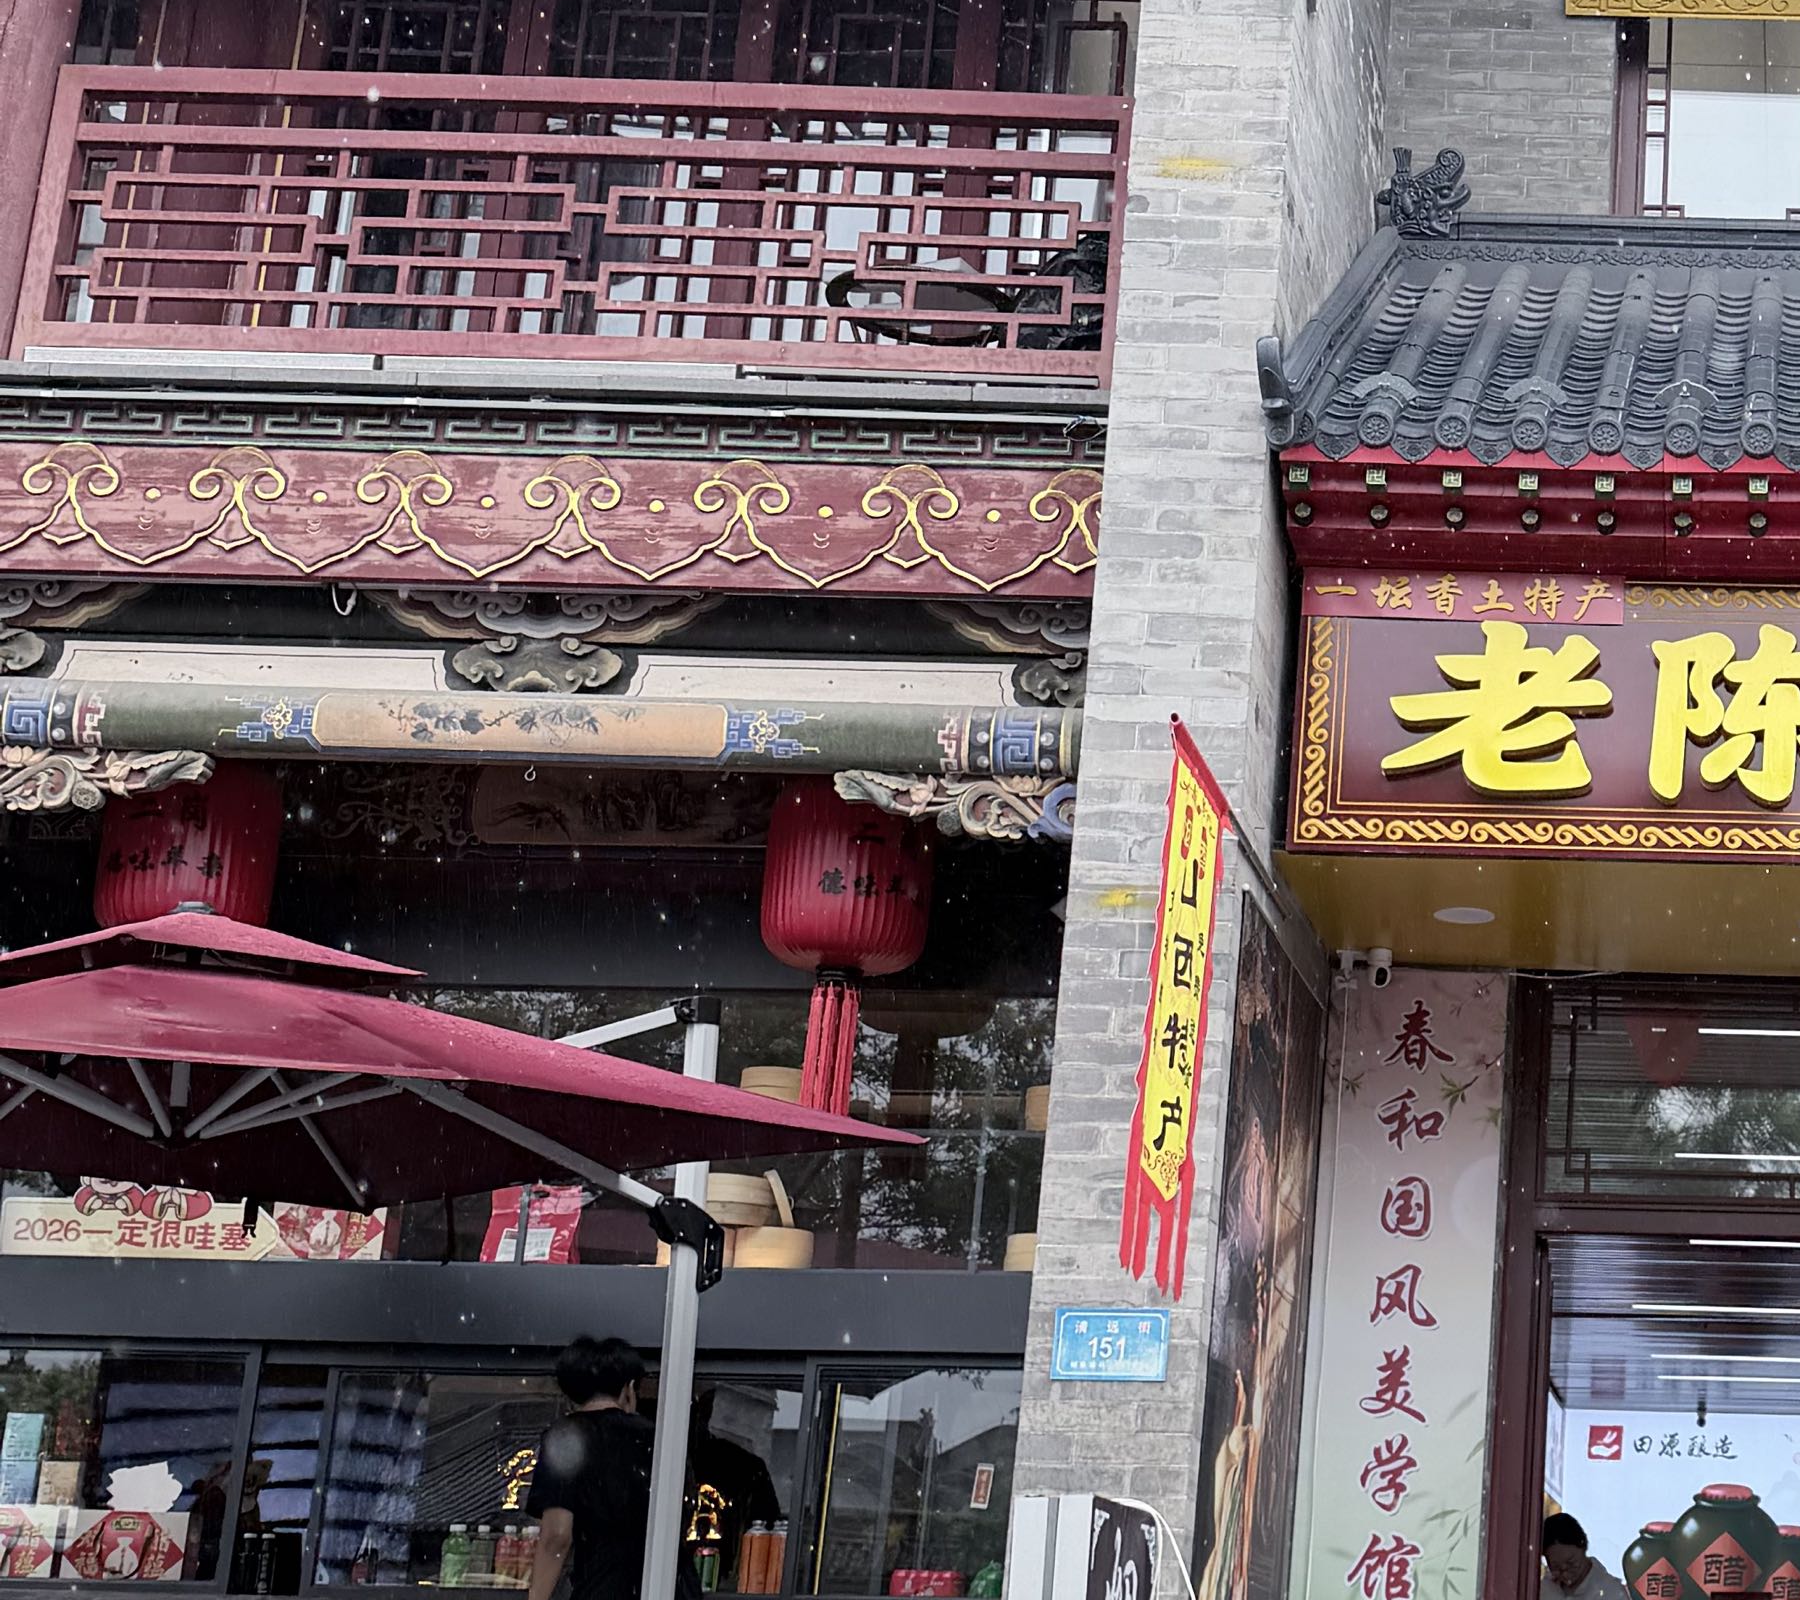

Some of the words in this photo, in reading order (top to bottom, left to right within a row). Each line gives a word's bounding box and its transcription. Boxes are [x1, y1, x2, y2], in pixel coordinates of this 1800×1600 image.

[1313, 572, 1615, 622] 一坛香土特产
[13, 1217, 254, 1252] 2026一定很哇塞
[1087, 1336, 1127, 1362] 151
[1632, 1432, 1740, 1460] 田源酿造
[1704, 1552, 1748, 1587] 醋
[1646, 1572, 1679, 1599] 醋
